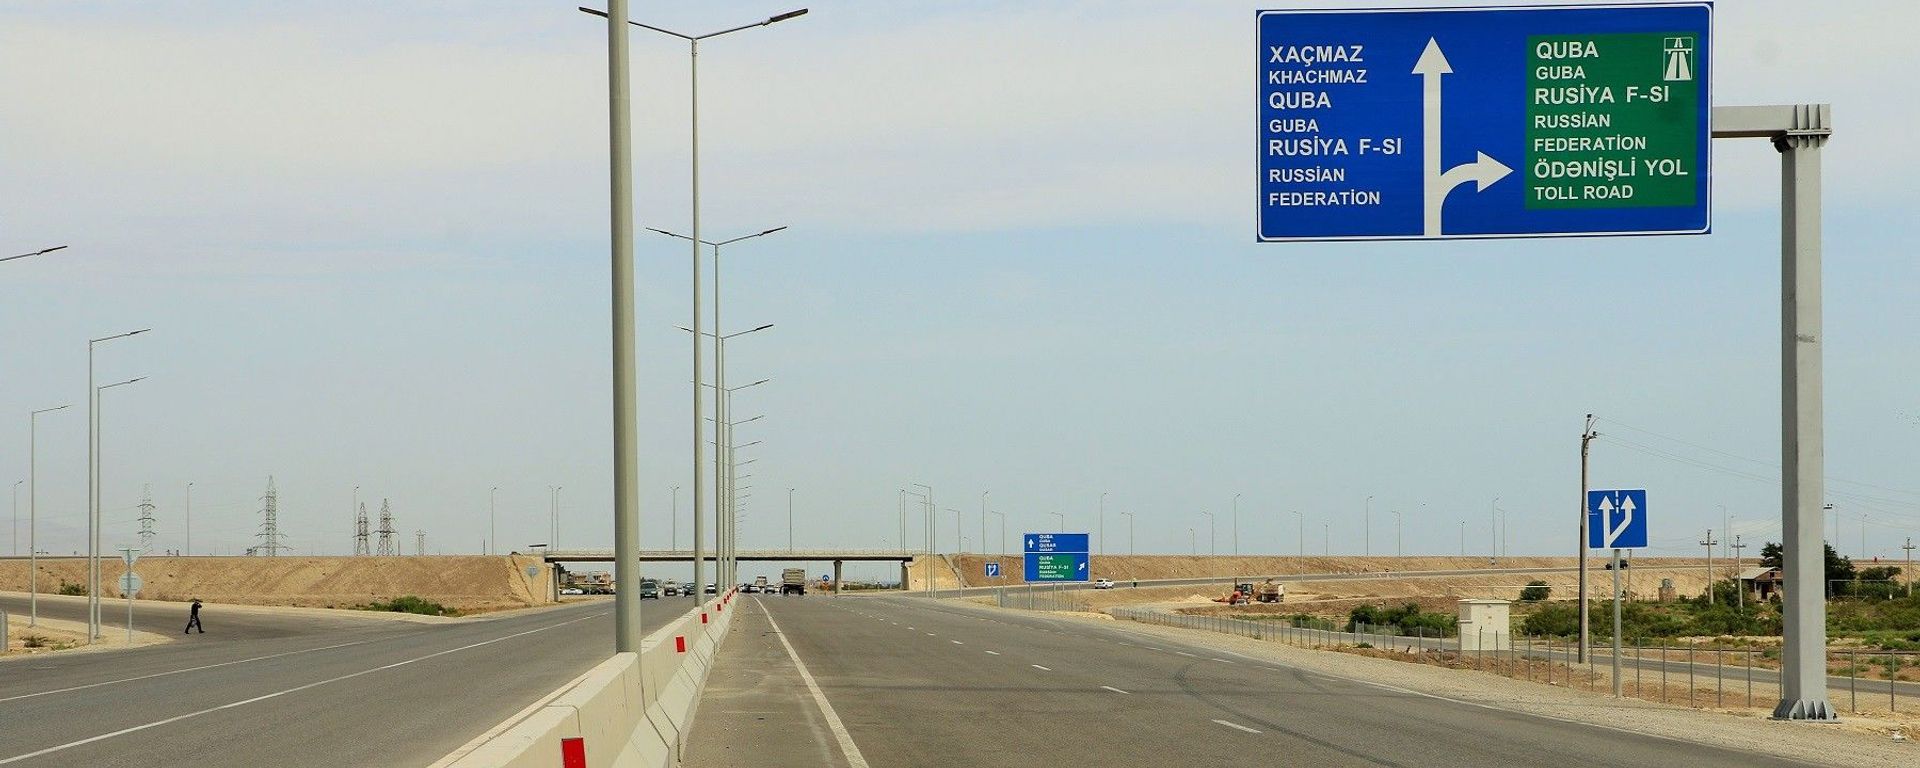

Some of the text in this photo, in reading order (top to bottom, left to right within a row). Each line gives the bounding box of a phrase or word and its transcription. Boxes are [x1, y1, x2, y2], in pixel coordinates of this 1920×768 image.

[1269, 45, 1364, 67] XAÇMAZ
[1536, 41, 1599, 60] QUBA
[1269, 69, 1367, 85] KHACHMAZ
[1535, 66, 1587, 80] GUBA
[1269, 91, 1332, 110] QUBA
[1535, 83, 1670, 105] RUSİYA F-SI
[1269, 118, 1320, 134] GUBA
[1534, 111, 1610, 129] RUSSİAN
[1269, 135, 1402, 156] RUSİYA F-SI
[1534, 134, 1646, 152] FEDERATİON
[1269, 165, 1345, 183] RUSSİAN
[1534, 156, 1688, 182] ÖDƏNİŞLİ YOL
[1269, 188, 1380, 206] FEDERATİON
[1533, 184, 1634, 200] TOLL ROAD
